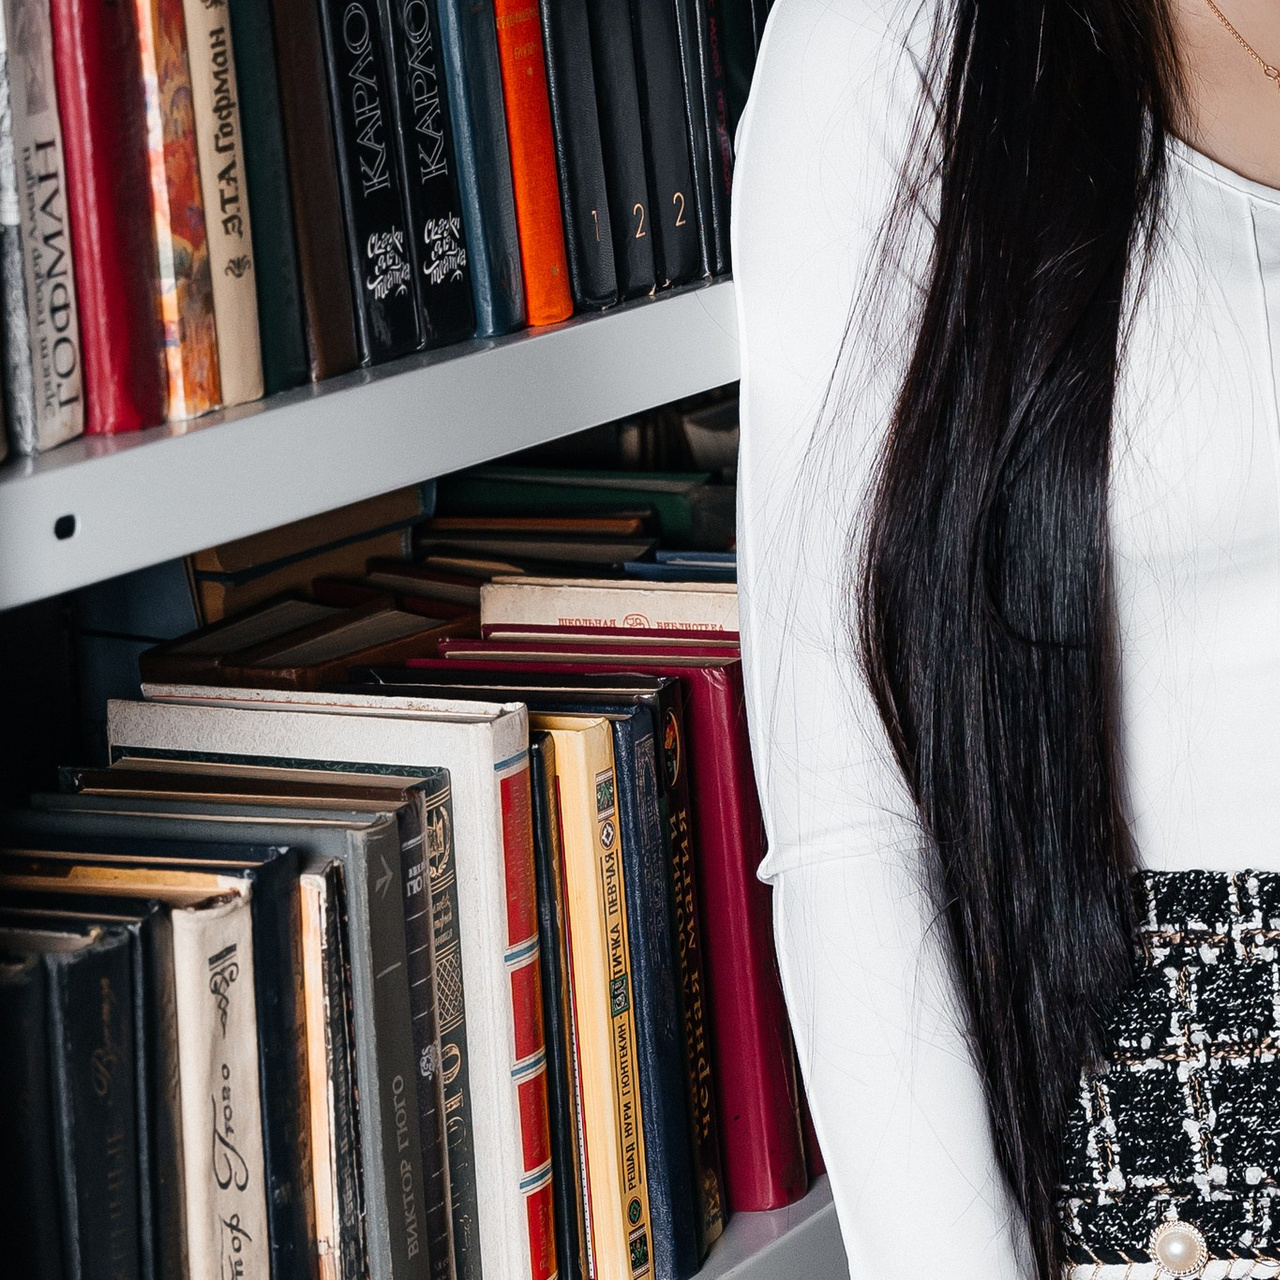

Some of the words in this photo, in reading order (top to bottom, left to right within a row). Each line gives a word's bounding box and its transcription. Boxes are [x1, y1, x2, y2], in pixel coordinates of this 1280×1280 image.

[208, 26, 238, 153] Гофман
[343, 3, 391, 197] КАРЛО
[632, 203, 647, 240] 2
[671, 190, 687, 228] 2
[35, 137, 80, 409] ГОФМАН
[602, 851, 620, 917] ПЕВЧАЯ
[676, 807, 698, 949] магия
[615, 1023, 632, 1097] ГЮНТЕКИН
[688, 968, 710, 1139] черная
[391, 1074, 413, 1152] ГЮГО
[620, 1100, 634, 1139] НУРИ
[623, 1142, 638, 1192] РЕШАД
[398, 1158, 421, 1261] ВИКТОР
